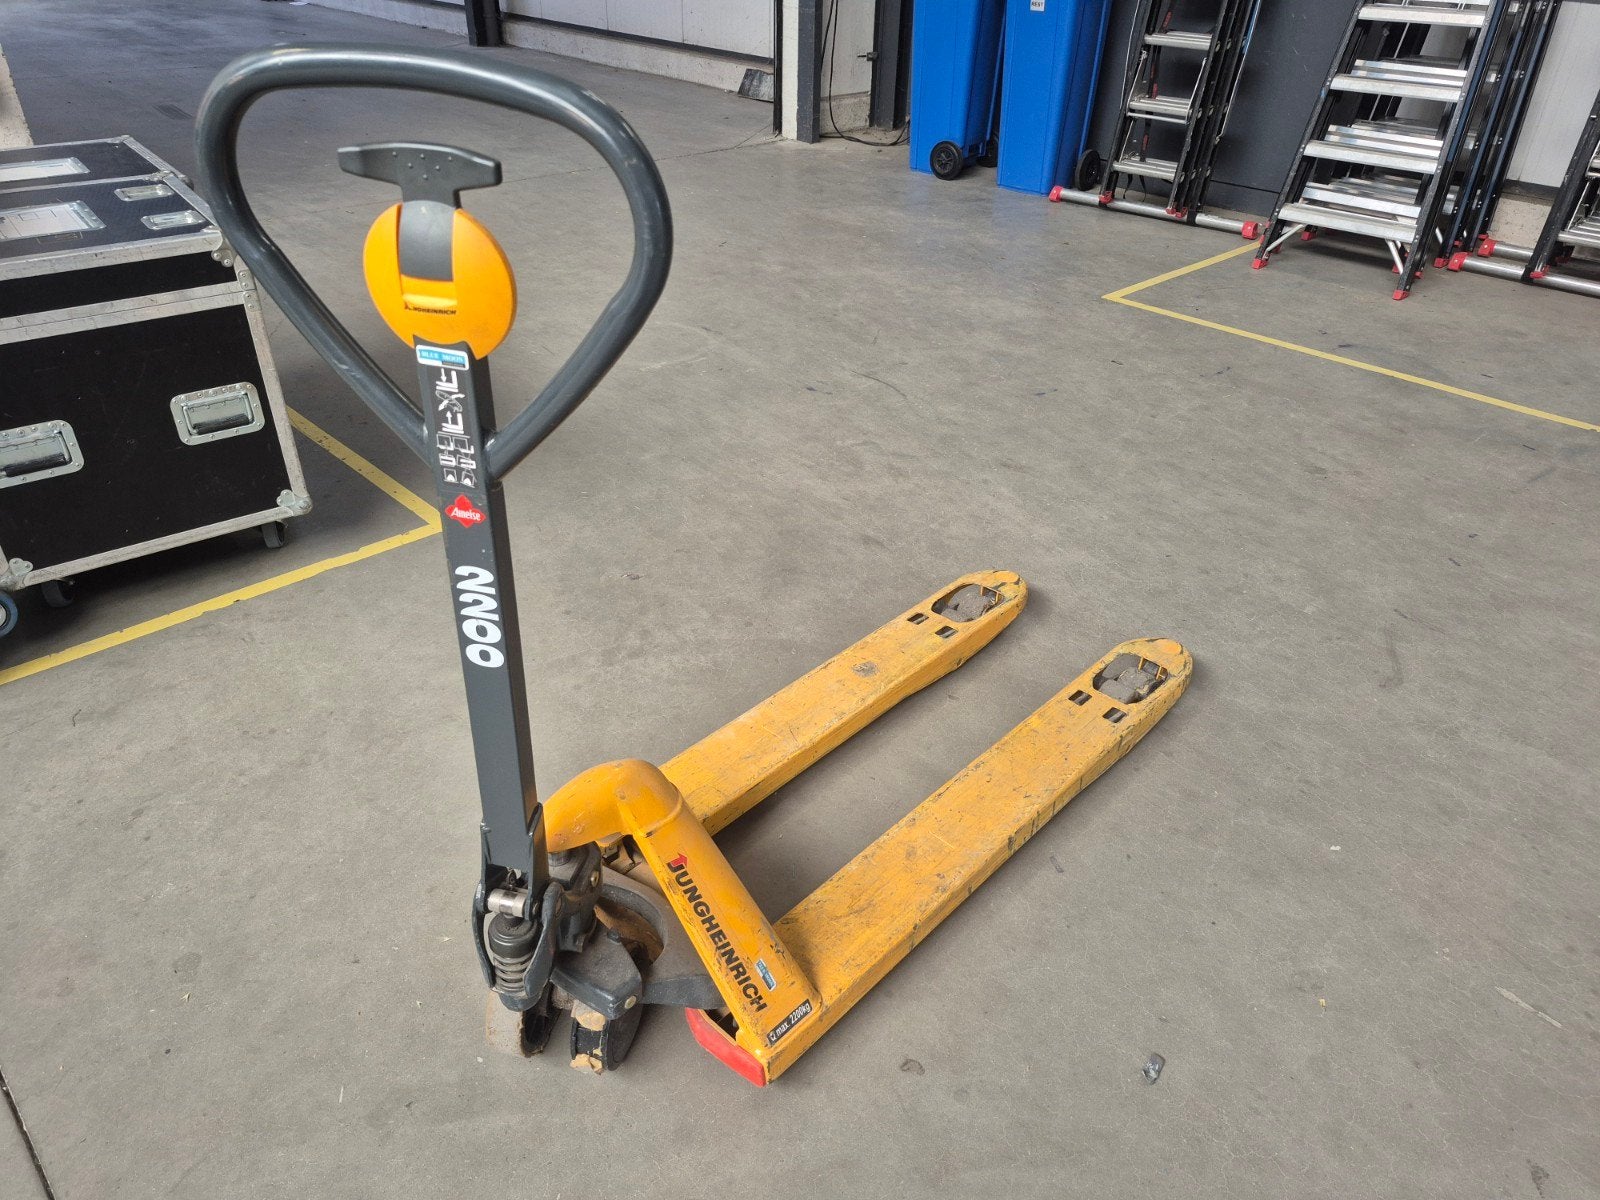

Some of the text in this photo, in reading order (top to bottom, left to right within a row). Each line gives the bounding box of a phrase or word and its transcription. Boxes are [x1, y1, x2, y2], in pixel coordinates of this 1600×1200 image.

[451, 507, 481, 521] Ameise
[455, 565, 504, 668] 2200
[666, 855, 768, 1012] JUNGHEINRICH
[790, 1002, 811, 1024] 2200kg
